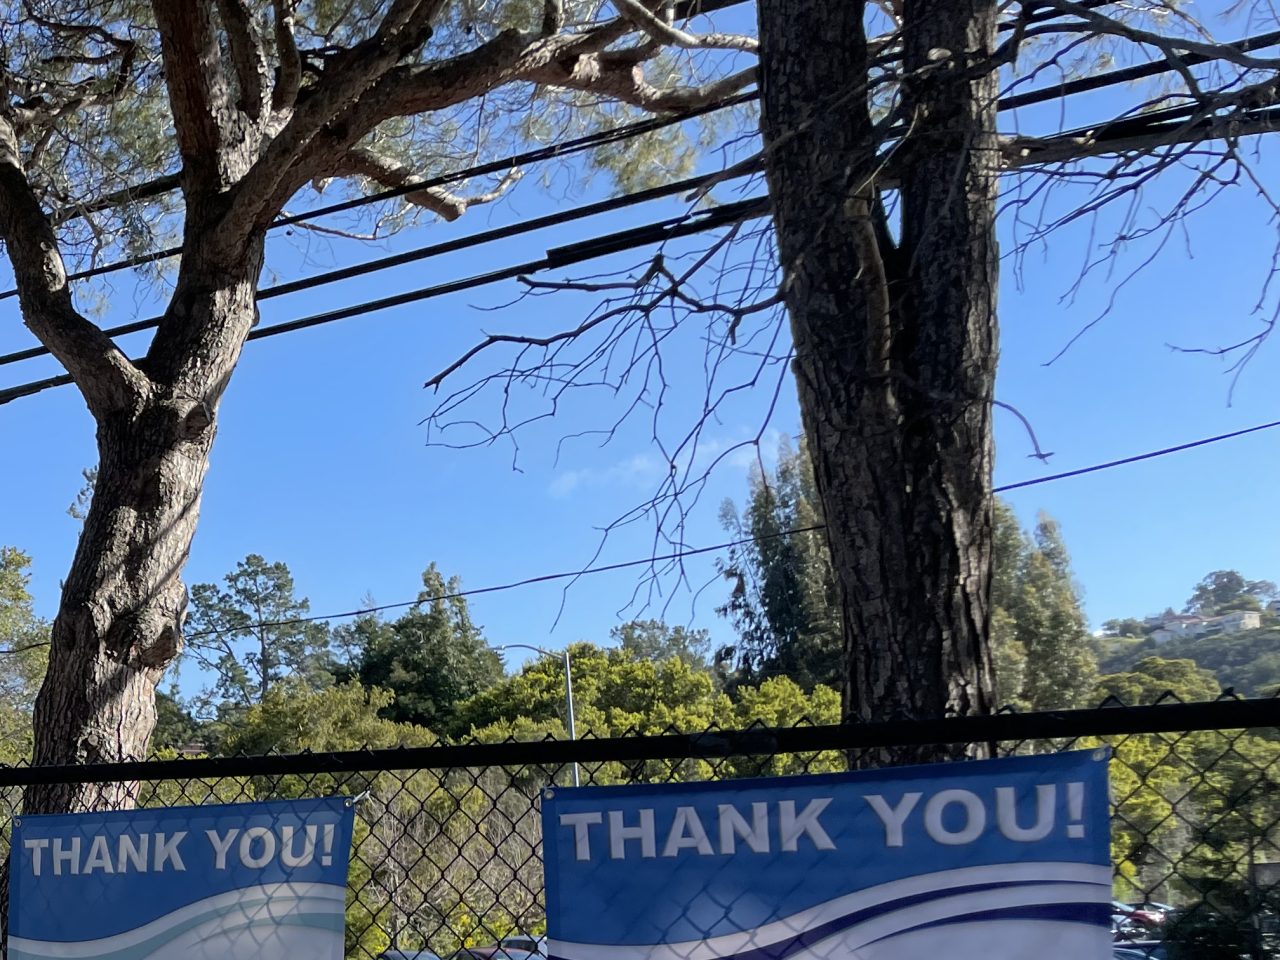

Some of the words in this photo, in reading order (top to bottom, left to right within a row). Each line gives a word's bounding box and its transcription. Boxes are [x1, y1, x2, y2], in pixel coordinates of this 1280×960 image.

[24, 831, 187, 877] THANK
[205, 824, 335, 870] YOU!
[560, 797, 837, 862] THANK
[864, 781, 1086, 848] YOU!
